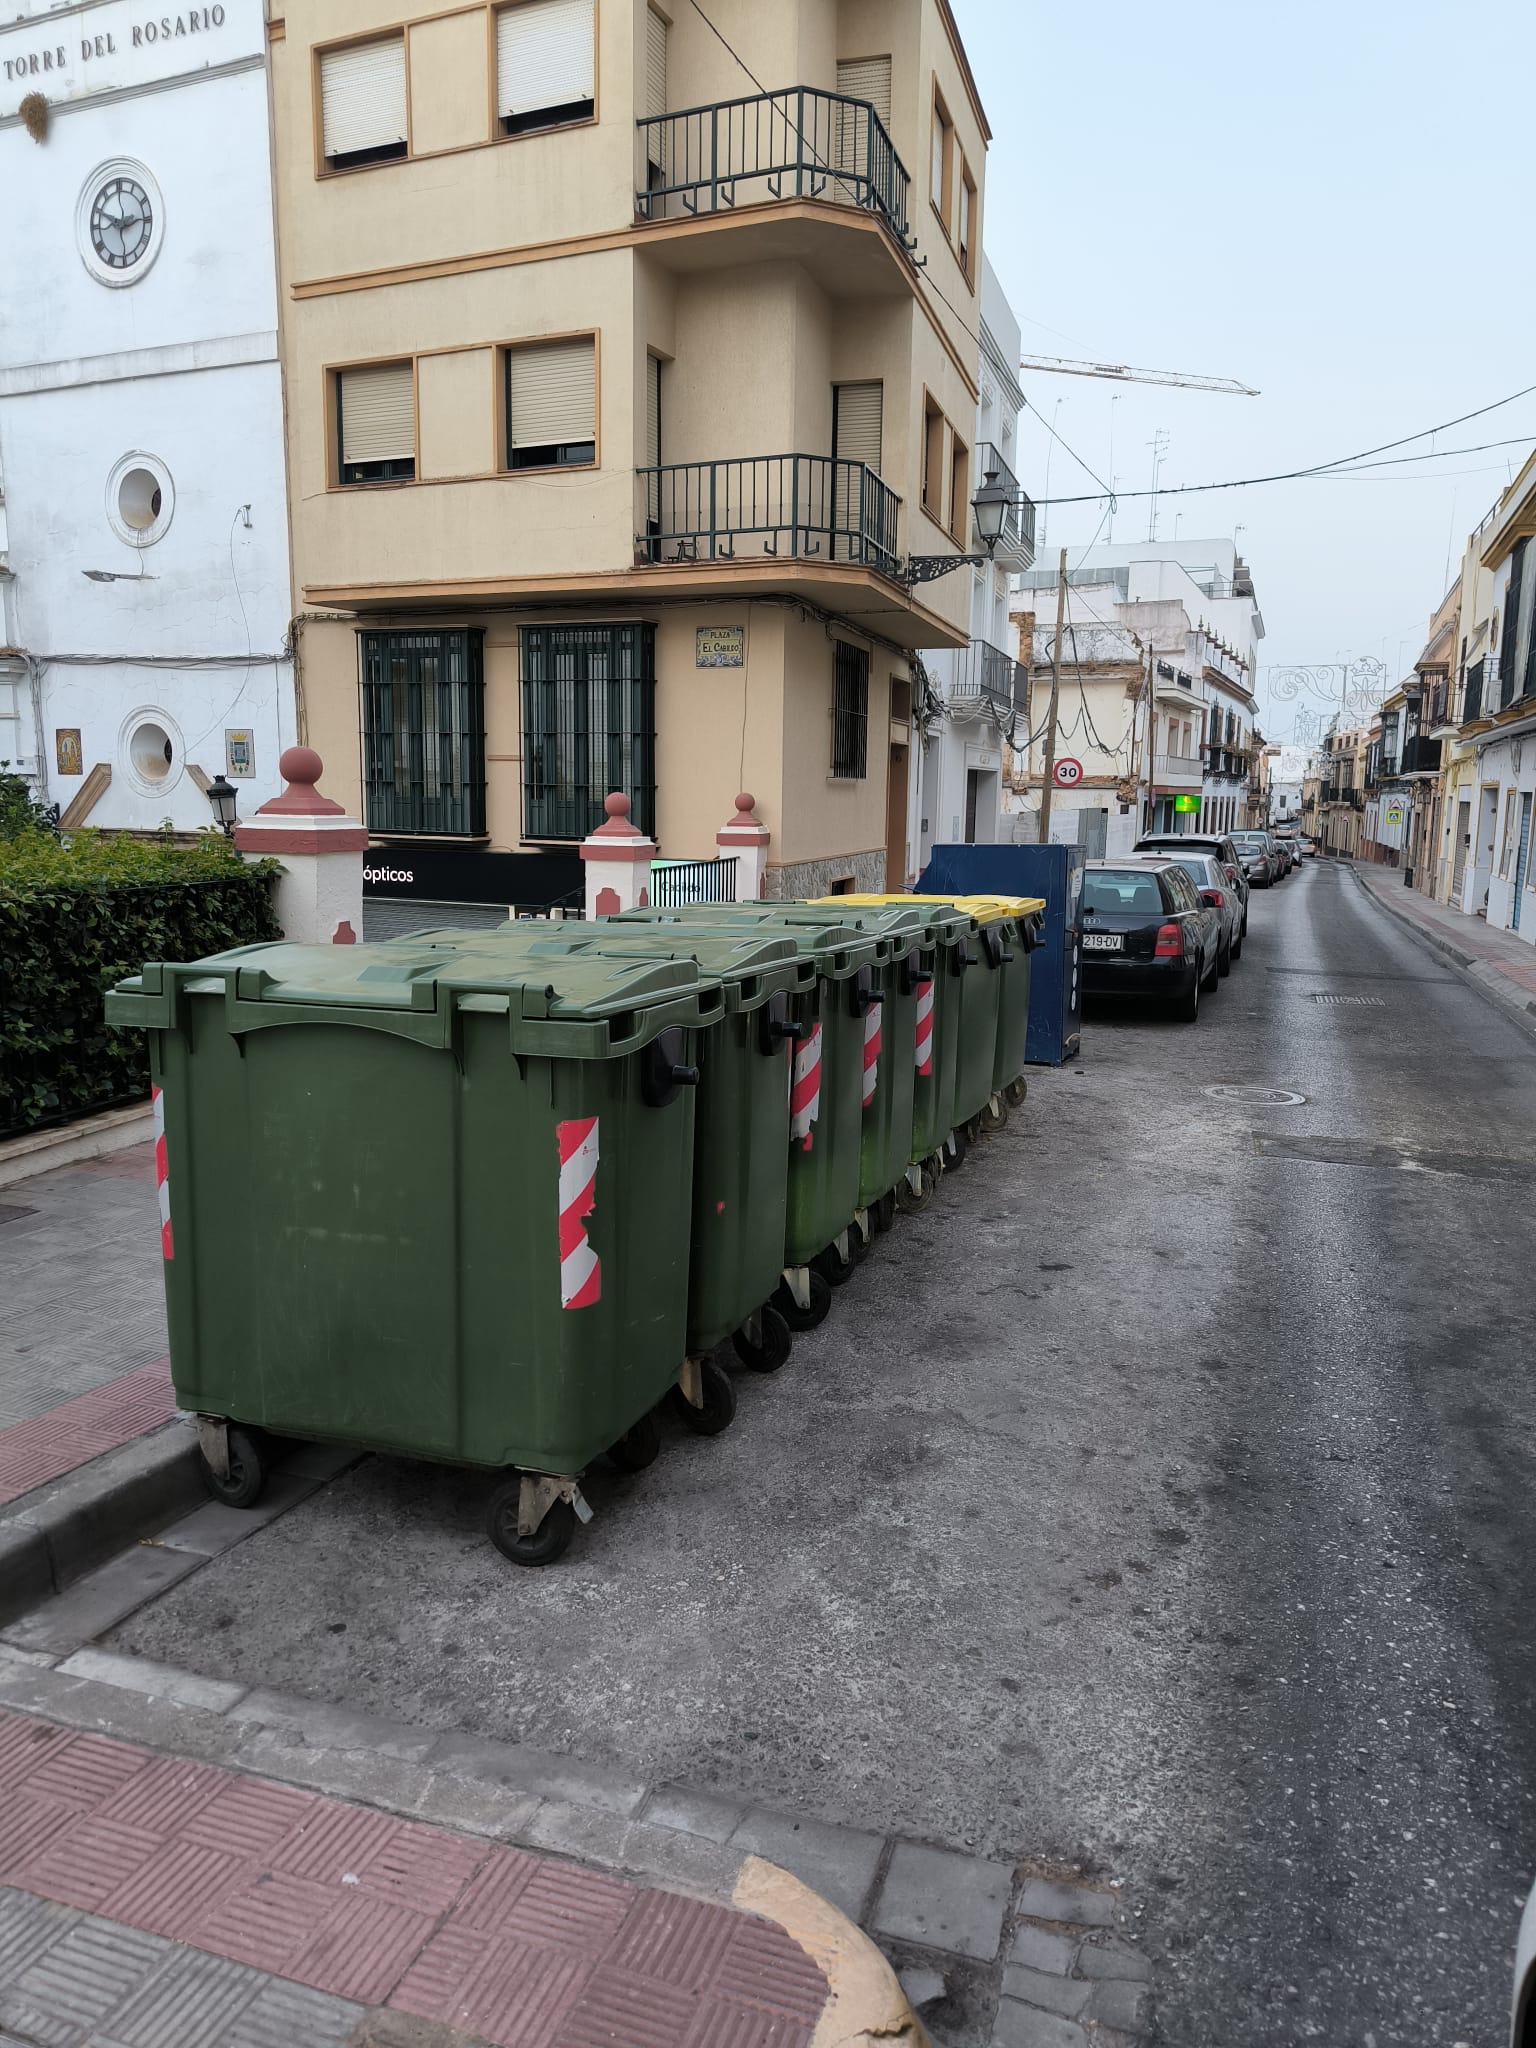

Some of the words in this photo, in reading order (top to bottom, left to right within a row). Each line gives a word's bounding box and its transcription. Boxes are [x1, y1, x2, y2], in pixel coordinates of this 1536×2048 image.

[4, 47, 67, 80] TORRE
[81, 33, 116, 61] DEL
[131, 4, 226, 48] ROSARIO
[710, 631, 730, 639] PLAZA
[1060, 767, 1077, 778] 30
[363, 864, 414, 884] ópticos
